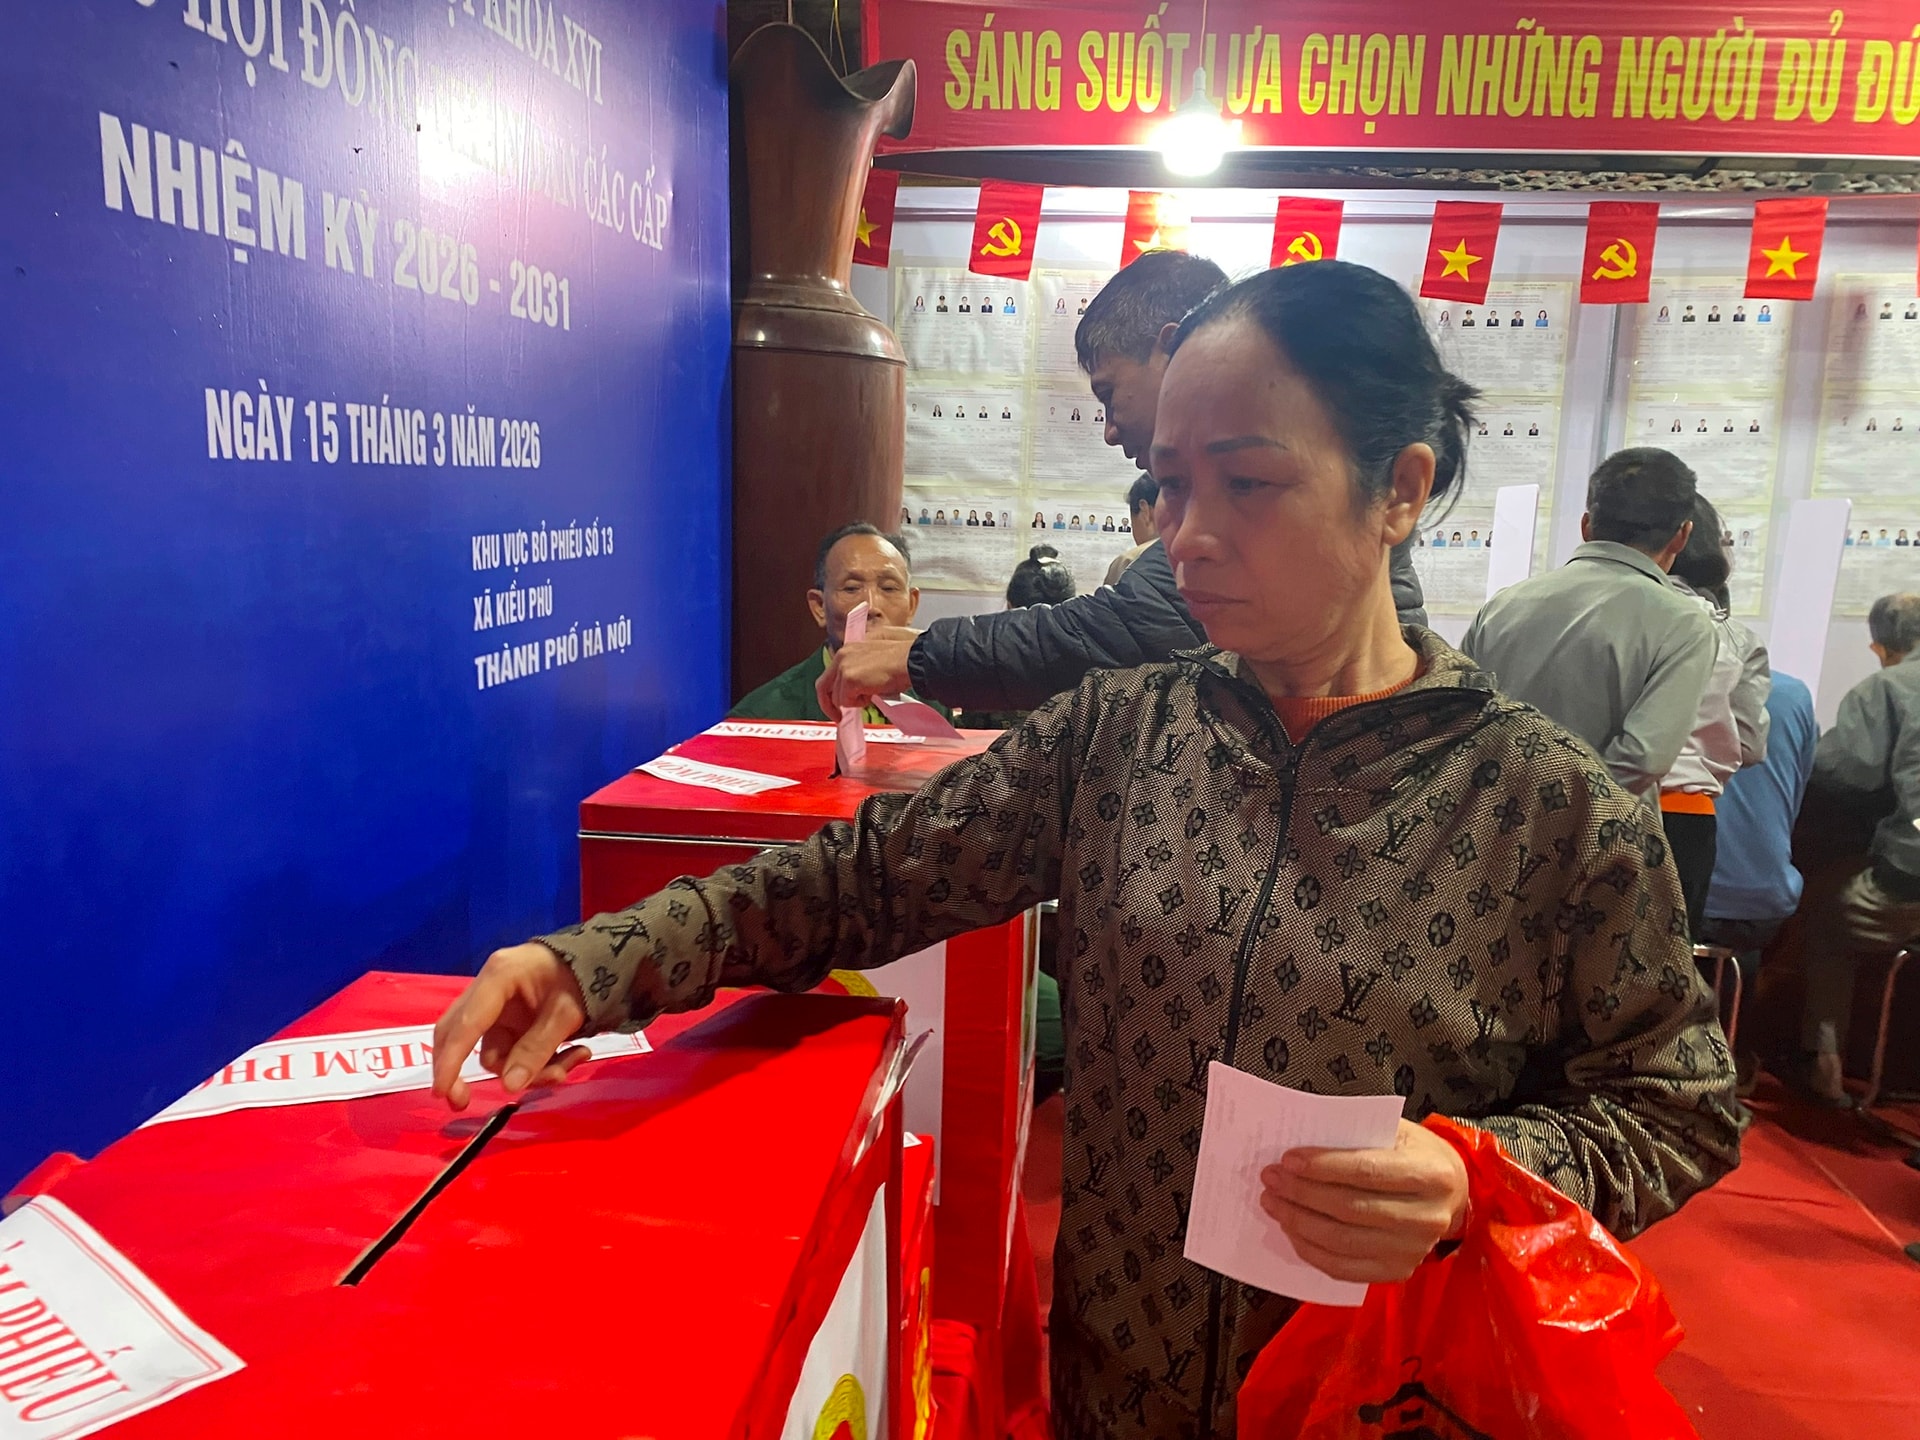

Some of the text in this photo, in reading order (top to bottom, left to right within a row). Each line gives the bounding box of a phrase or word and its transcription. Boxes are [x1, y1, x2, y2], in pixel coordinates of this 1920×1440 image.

[563, 14, 603, 105] XVI
[944, 12, 1062, 112] SÁNG
[1076, 3, 1190, 113] SUỐT
[1298, 33, 1426, 134] CHỌN
[1436, 17, 1603, 118] NHỮNG
[1612, 16, 1767, 121] NGƯỜI
[1774, 9, 1846, 123] ĐỦ
[100, 112, 306, 263] NHIỆM
[393, 218, 479, 306] 2026
[510, 260, 570, 331] 2031
[583, 143, 625, 233] CÁC
[630, 163, 667, 251] CẤP
[205, 378, 541, 469] NGÀY 15 THÁNG 3 NĂM 2026
[472, 516, 614, 572] KHU VỰC BỎ PHIẾU SỐ 13
[473, 578, 553, 632] XÃ KIỀU PHÚ
[474, 614, 632, 691] THÀNH PHỐ HÀ NỘI
